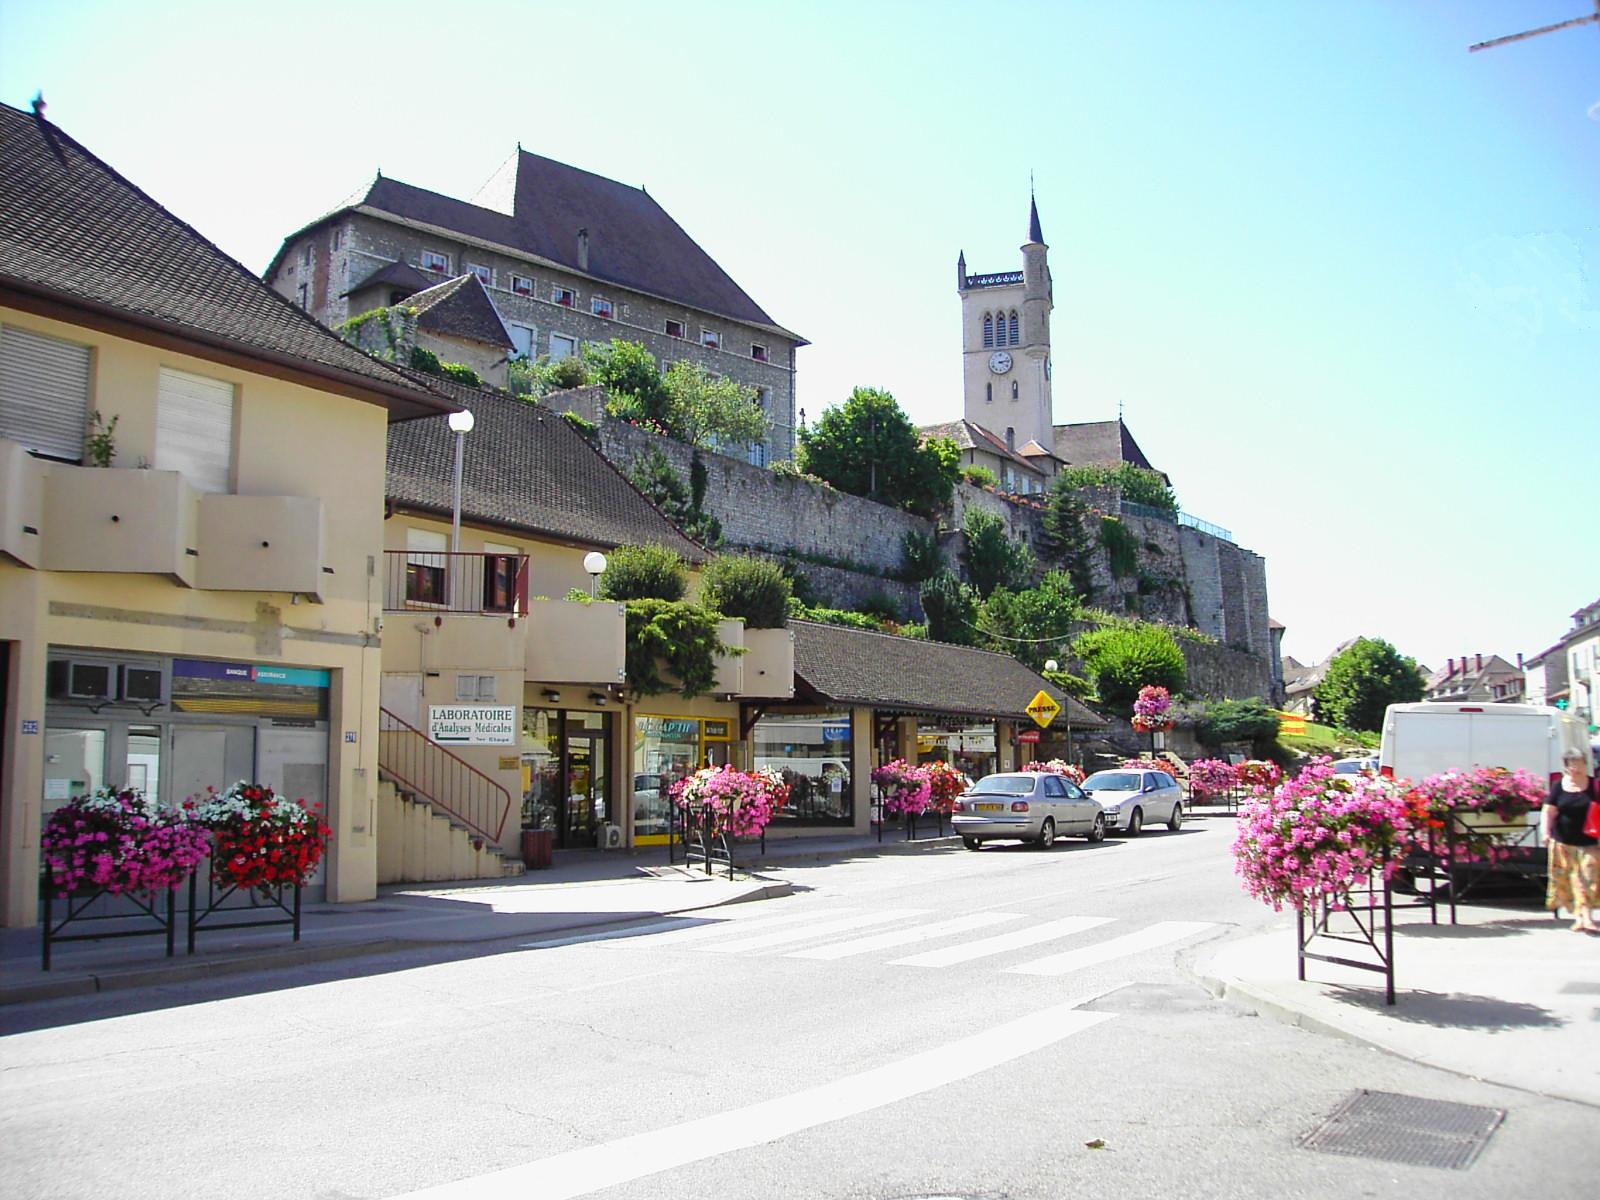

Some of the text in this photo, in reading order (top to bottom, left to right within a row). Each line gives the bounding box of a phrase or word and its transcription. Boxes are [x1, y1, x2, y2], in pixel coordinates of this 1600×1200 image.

[432, 709, 512, 721] LABORATOIRE
[1028, 705, 1056, 713] PRESSE
[432, 722, 512, 734] d'Analyses Médicales
